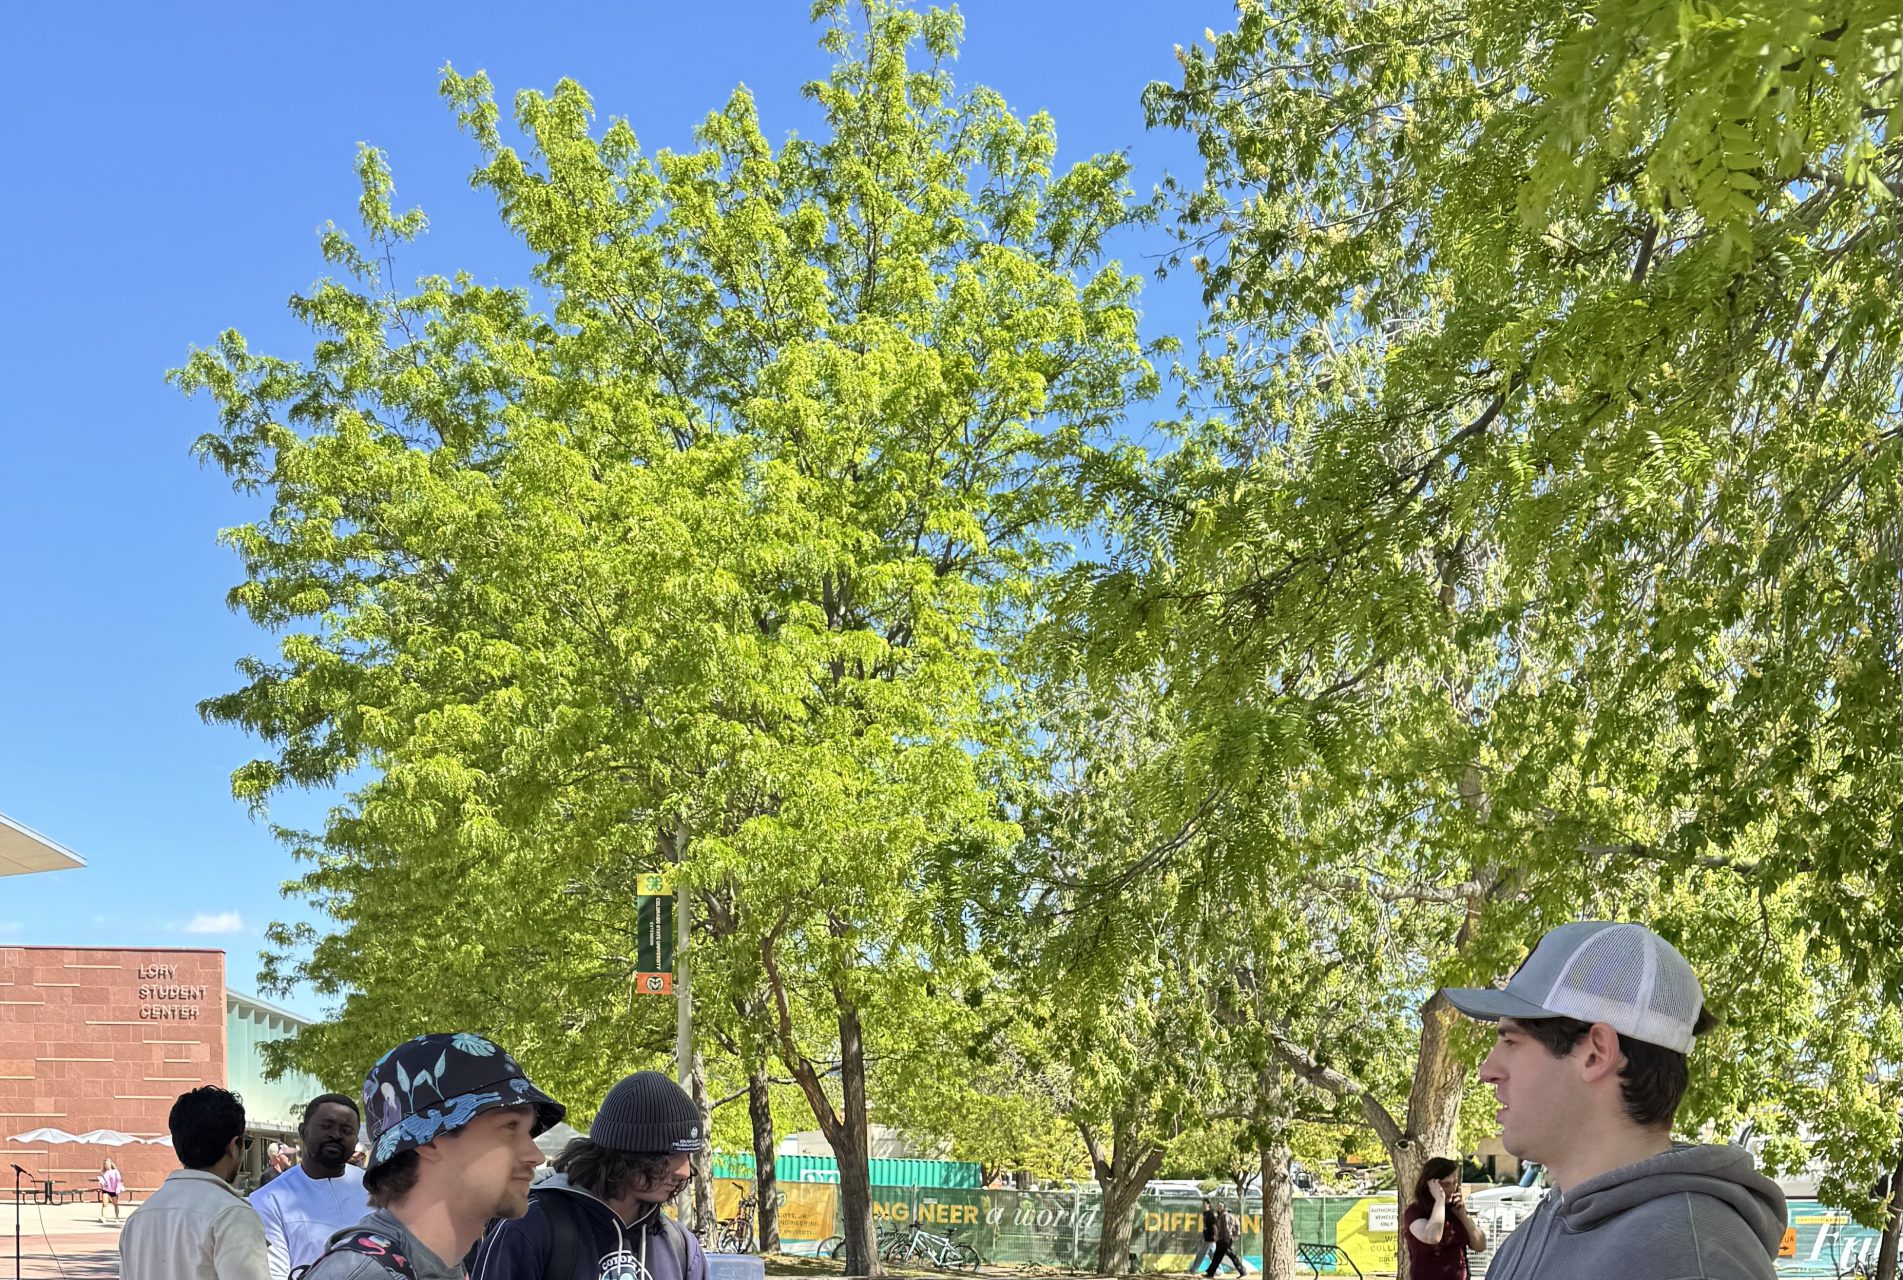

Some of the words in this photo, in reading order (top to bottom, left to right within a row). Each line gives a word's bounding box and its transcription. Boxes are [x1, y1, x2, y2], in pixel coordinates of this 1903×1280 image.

[138, 964, 178, 979] LORY
[139, 984, 209, 1000] STUDENT
[139, 1004, 200, 1020] CENTER
